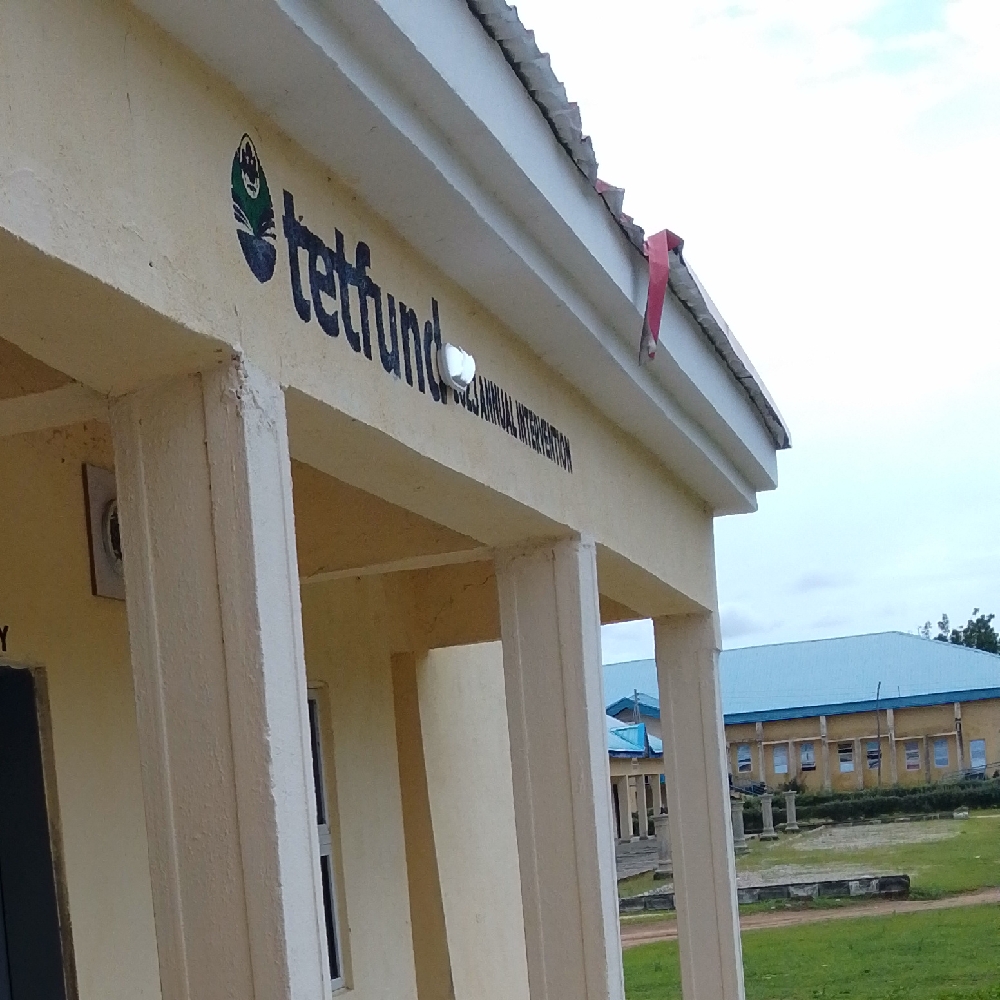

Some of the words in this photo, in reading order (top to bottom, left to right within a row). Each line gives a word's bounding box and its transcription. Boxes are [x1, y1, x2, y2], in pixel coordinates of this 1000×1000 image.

[282, 189, 448, 404] tetfund
[479, 375, 517, 438] ANNUAL
[515, 400, 573, 474] INTERVENTION
